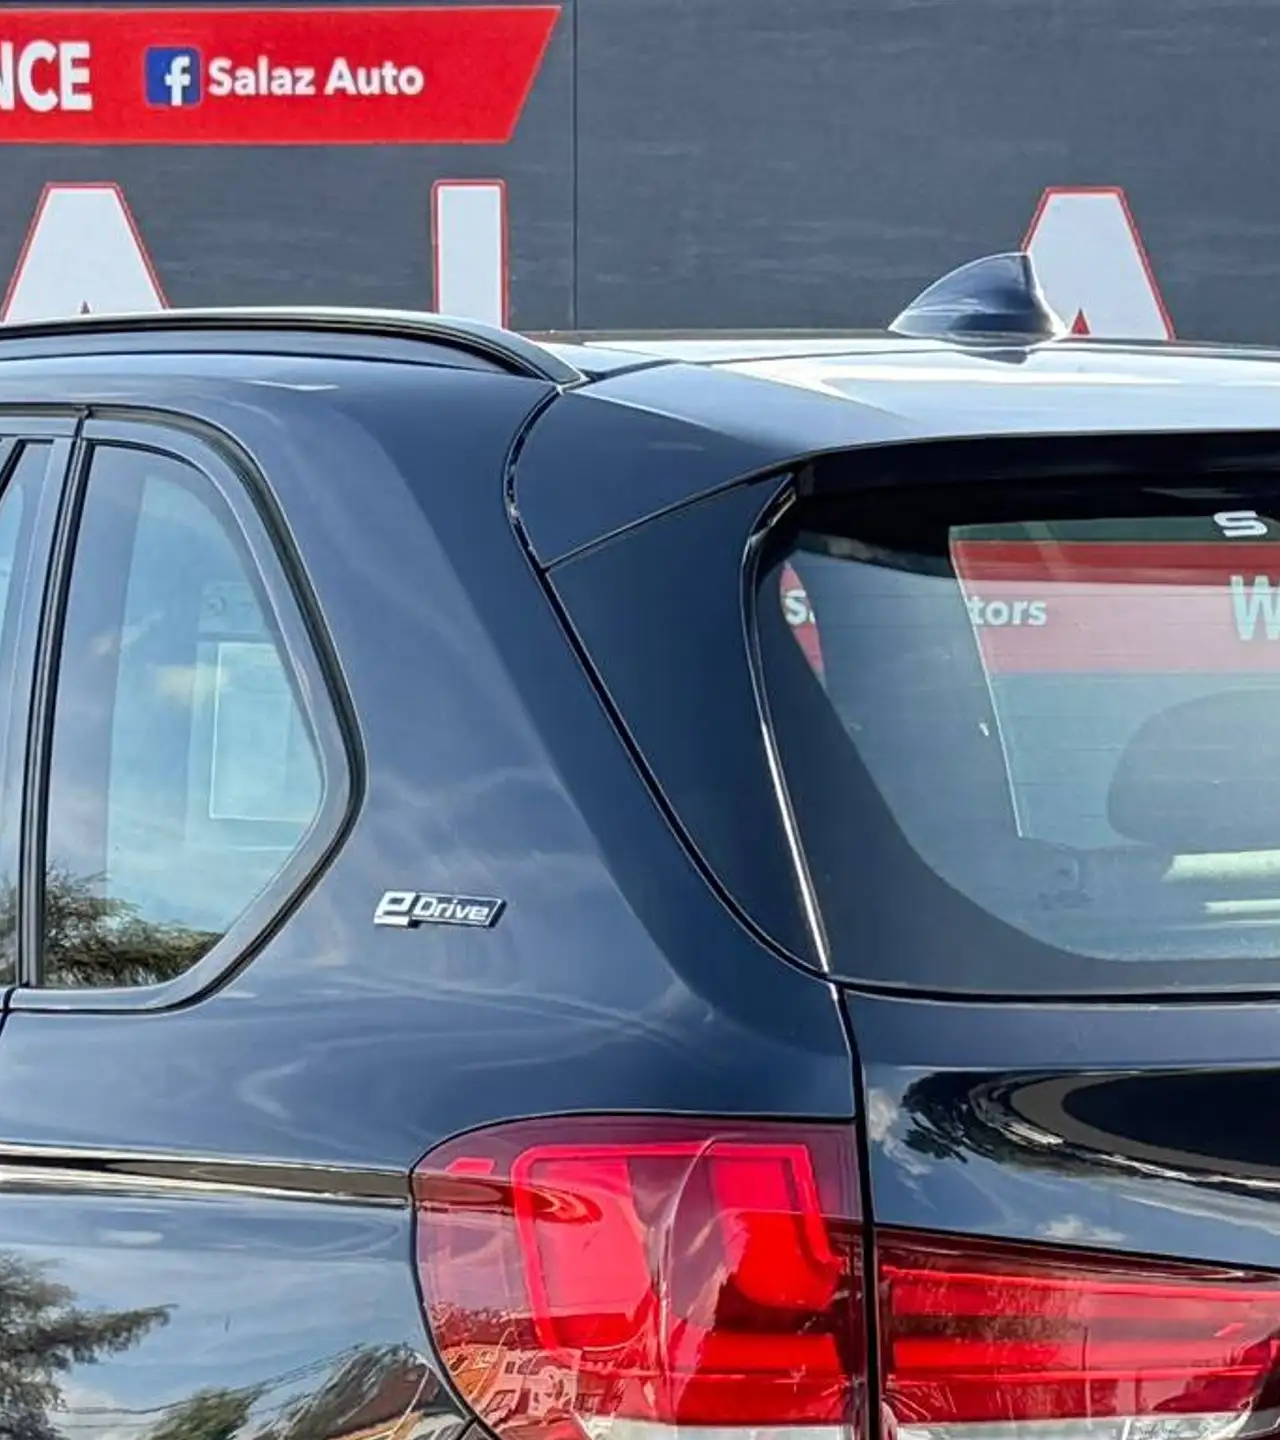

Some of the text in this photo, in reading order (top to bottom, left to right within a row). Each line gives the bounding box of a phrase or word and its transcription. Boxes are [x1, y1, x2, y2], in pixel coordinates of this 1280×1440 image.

[207, 54, 317, 97] Salaz
[323, 56, 425, 96] Auto
[373, 890, 491, 928] eDrive
